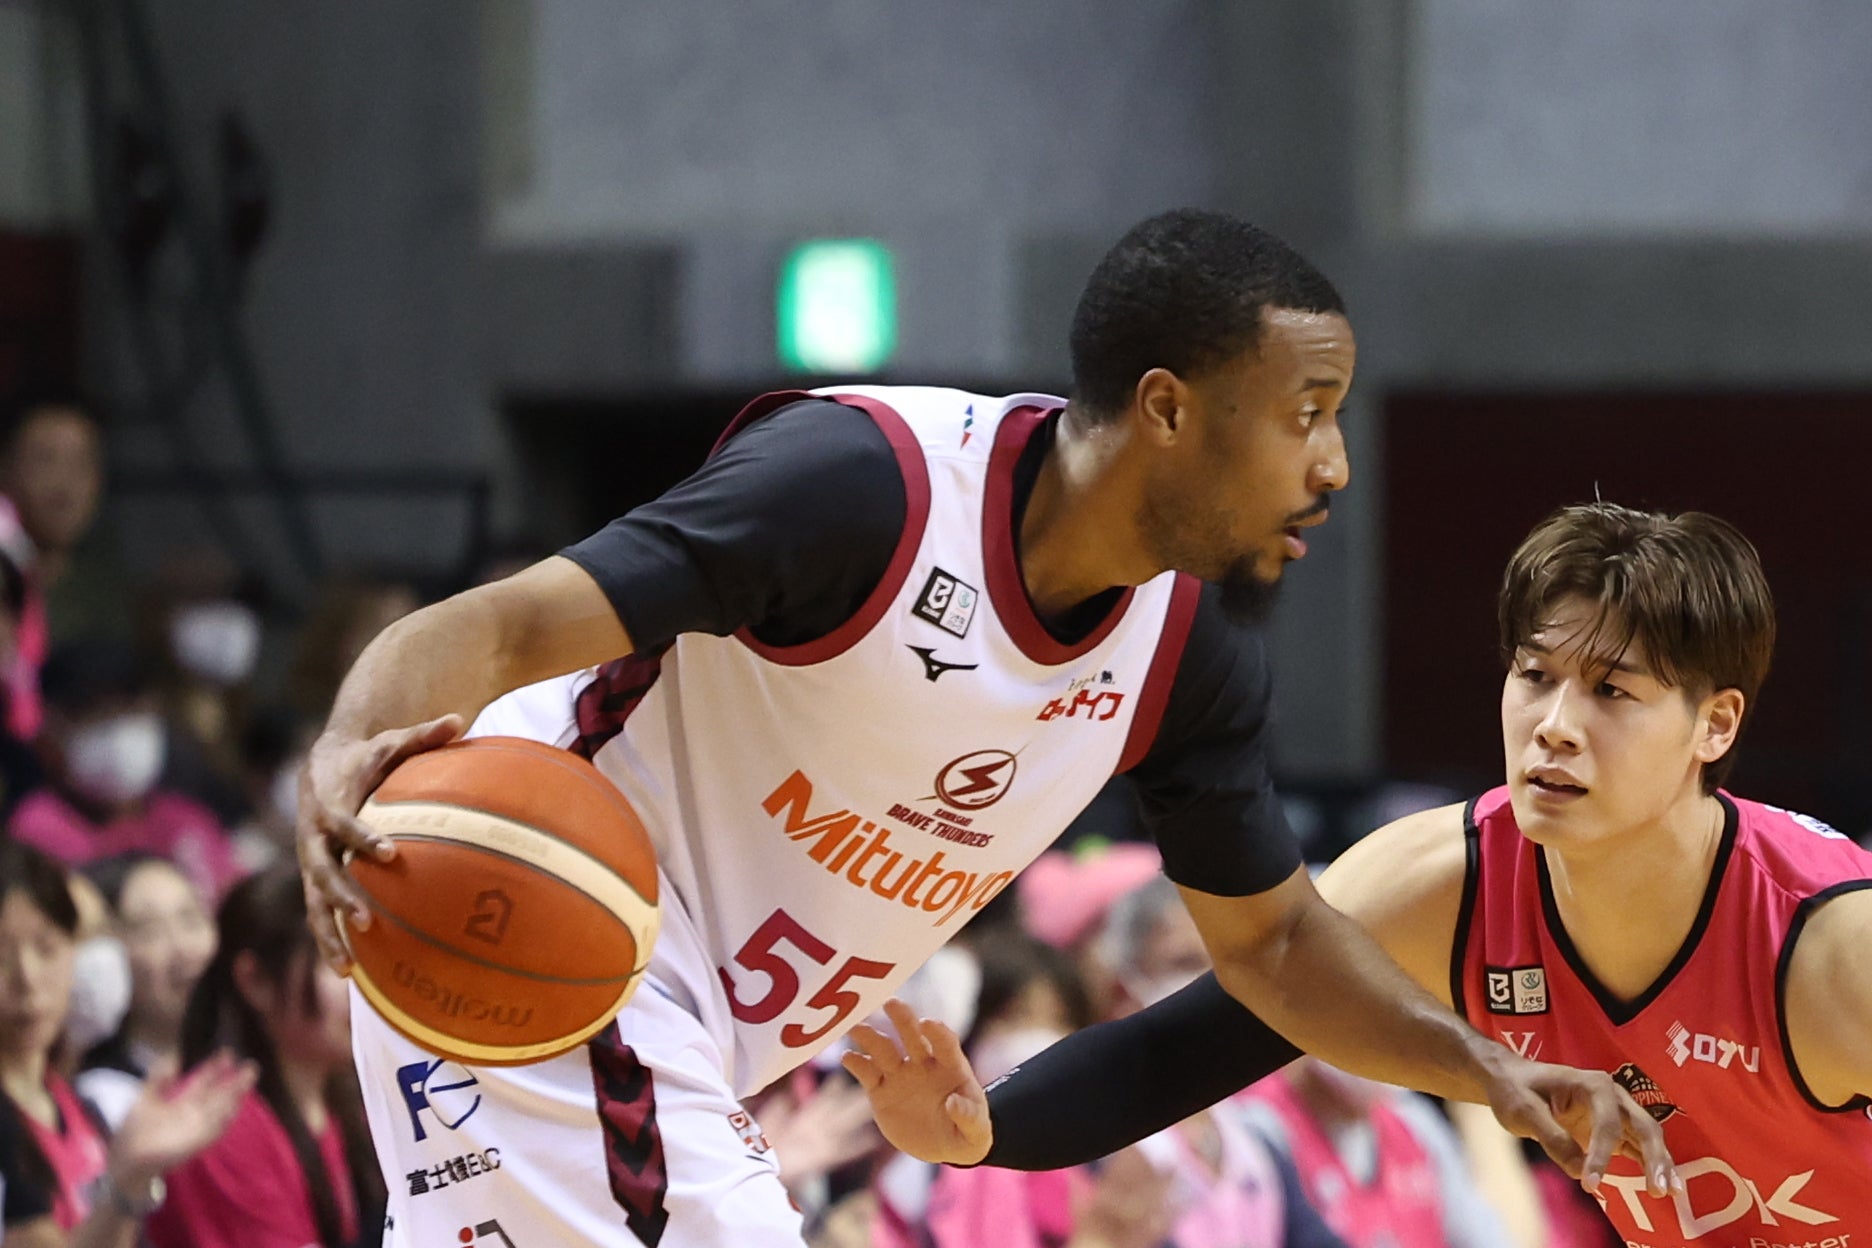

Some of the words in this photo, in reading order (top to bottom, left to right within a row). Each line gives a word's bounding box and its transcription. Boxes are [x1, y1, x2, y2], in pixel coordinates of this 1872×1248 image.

[761, 769, 1015, 928] Mitutoyo
[885, 803, 935, 831] BRAVE
[930, 822, 996, 848] THUNDERS
[391, 961, 534, 1028] molten
[718, 907, 897, 1048] 55
[1600, 1156, 1840, 1240] TDK
